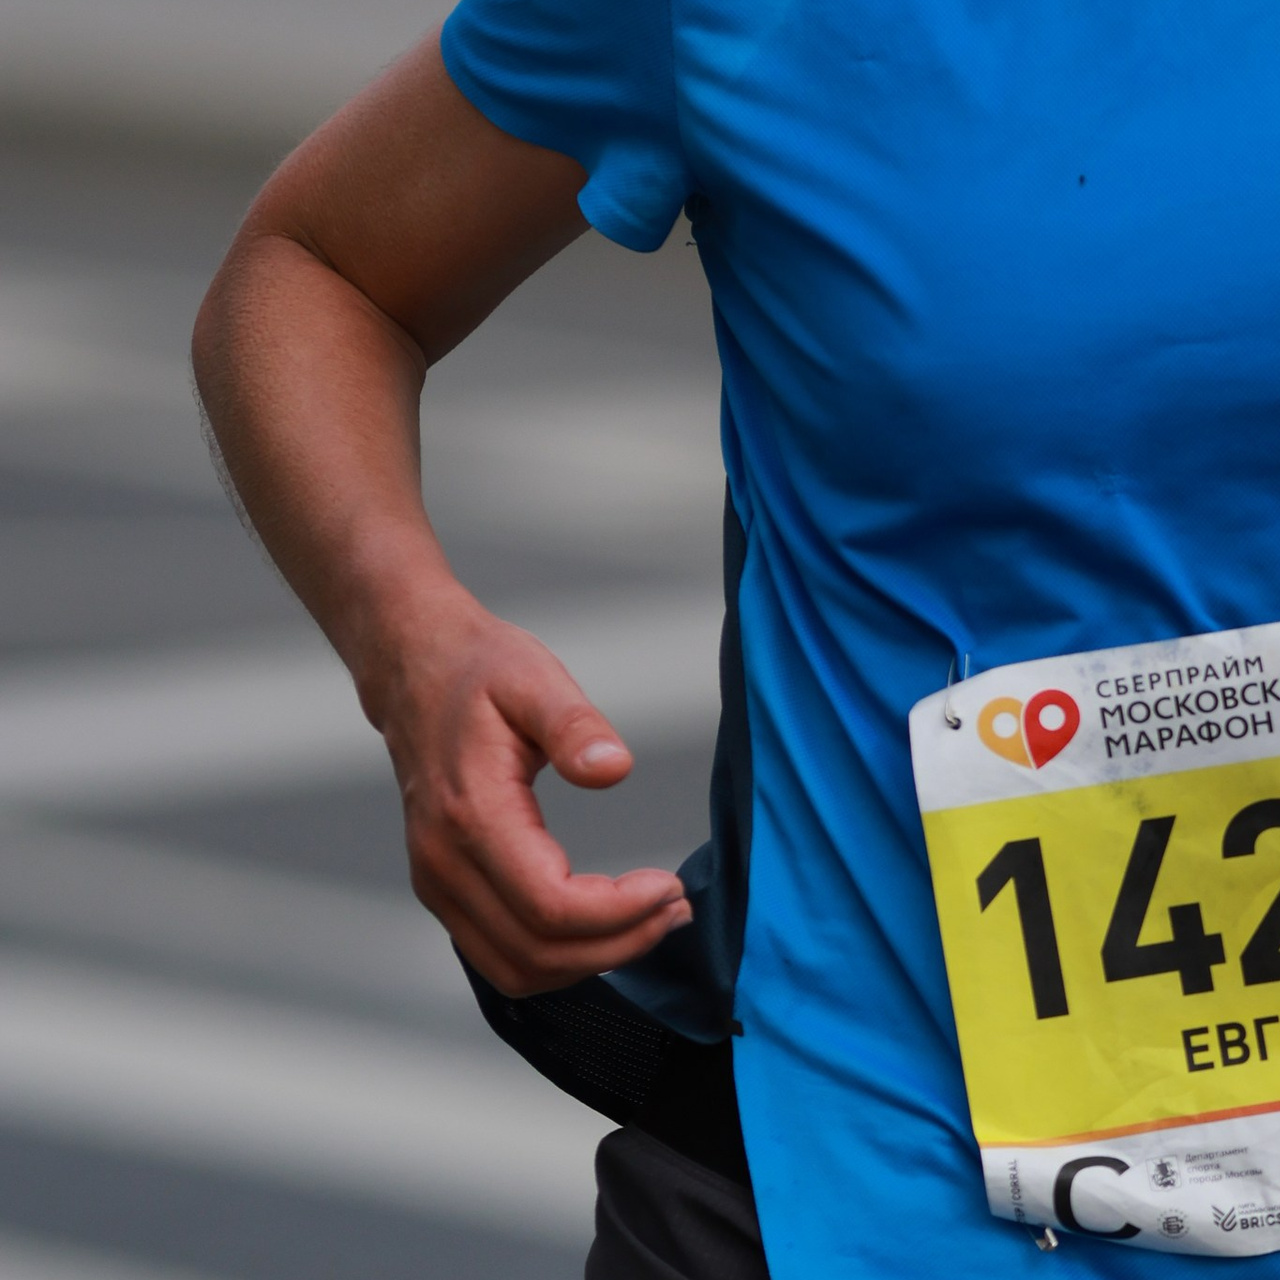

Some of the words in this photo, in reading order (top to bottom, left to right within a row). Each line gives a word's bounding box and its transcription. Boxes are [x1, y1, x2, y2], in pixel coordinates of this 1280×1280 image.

[1096, 656, 1264, 698] СБЕРПРАЙМ
[1104, 711, 1274, 758] МАРАФОН
[1185, 1146, 1249, 1163] Департамент
[1187, 1163, 1220, 1174] спорта
